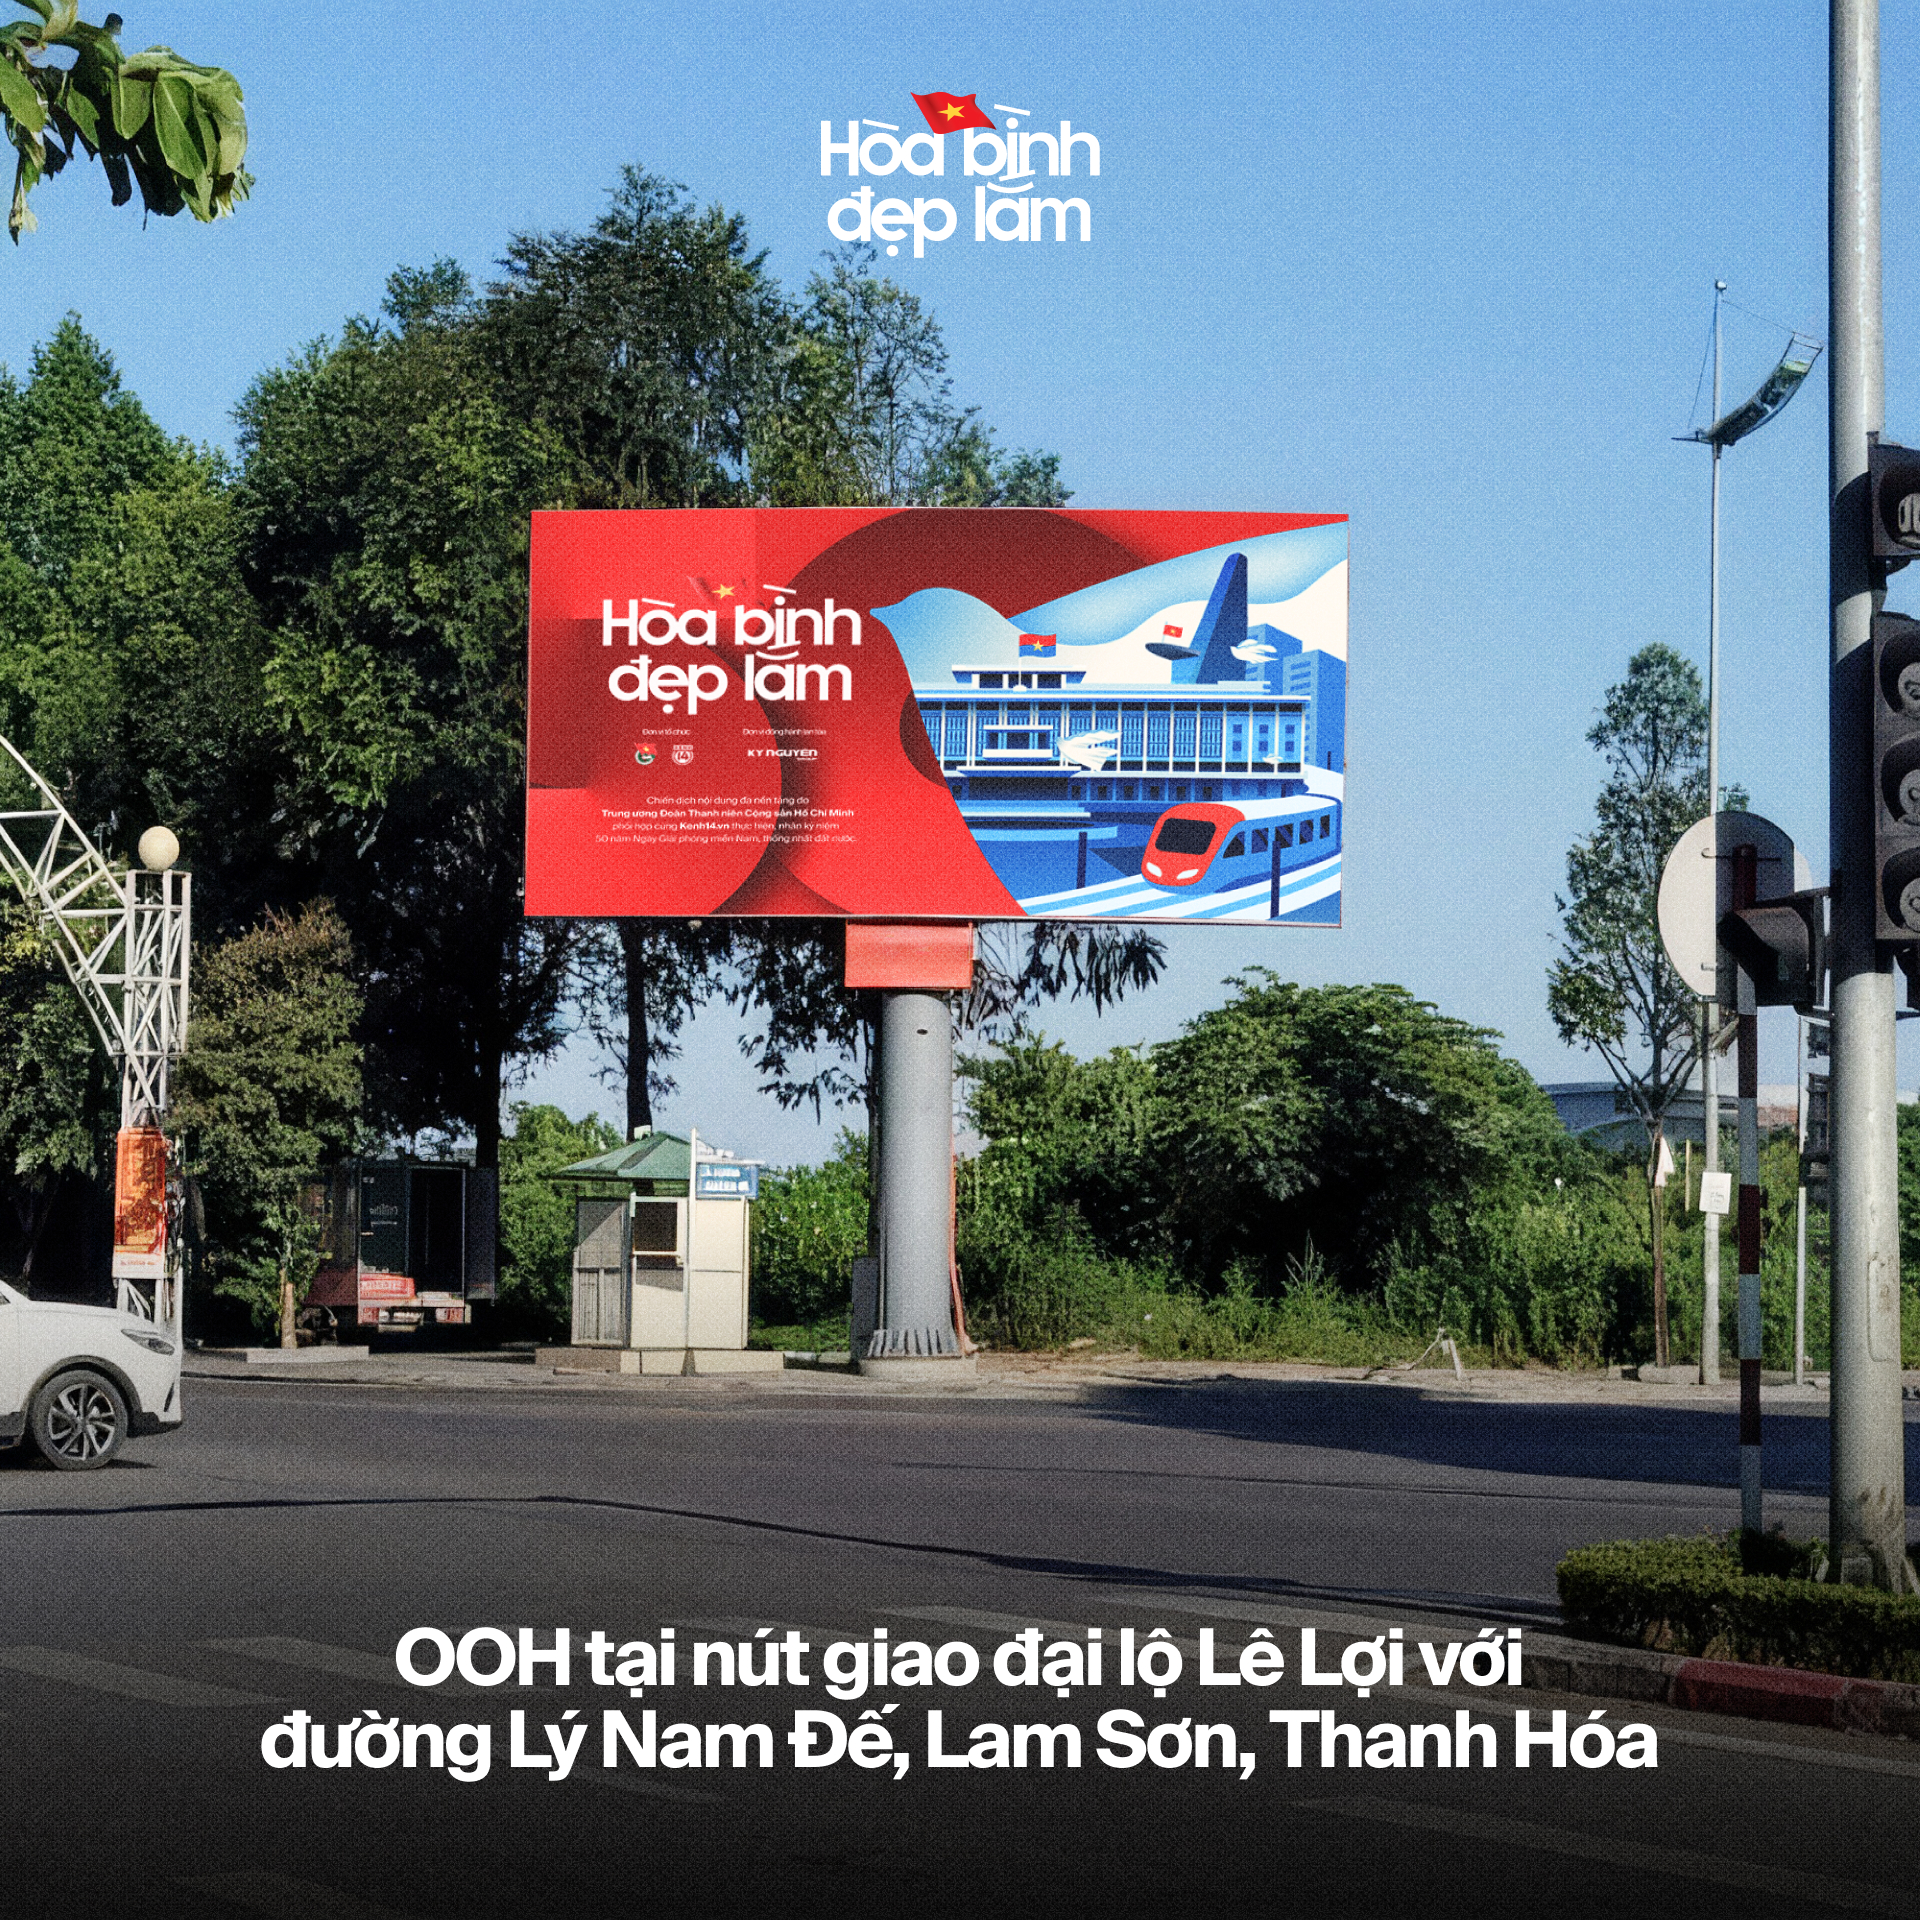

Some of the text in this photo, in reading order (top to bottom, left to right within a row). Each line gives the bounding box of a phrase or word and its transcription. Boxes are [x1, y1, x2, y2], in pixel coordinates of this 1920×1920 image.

[602, 584, 862, 647] Hòa bình
[608, 645, 853, 715] đẹp lắm
[713, 796, 738, 806] dung
[601, 809, 630, 818] Trung
[659, 809, 686, 817] Đoàn
[688, 809, 719, 817] Thanh
[721, 809, 743, 817] niên
[828, 809, 854, 817] Minh
[680, 822, 730, 830] Kenh14.vn
[595, 834, 608, 843] 50
